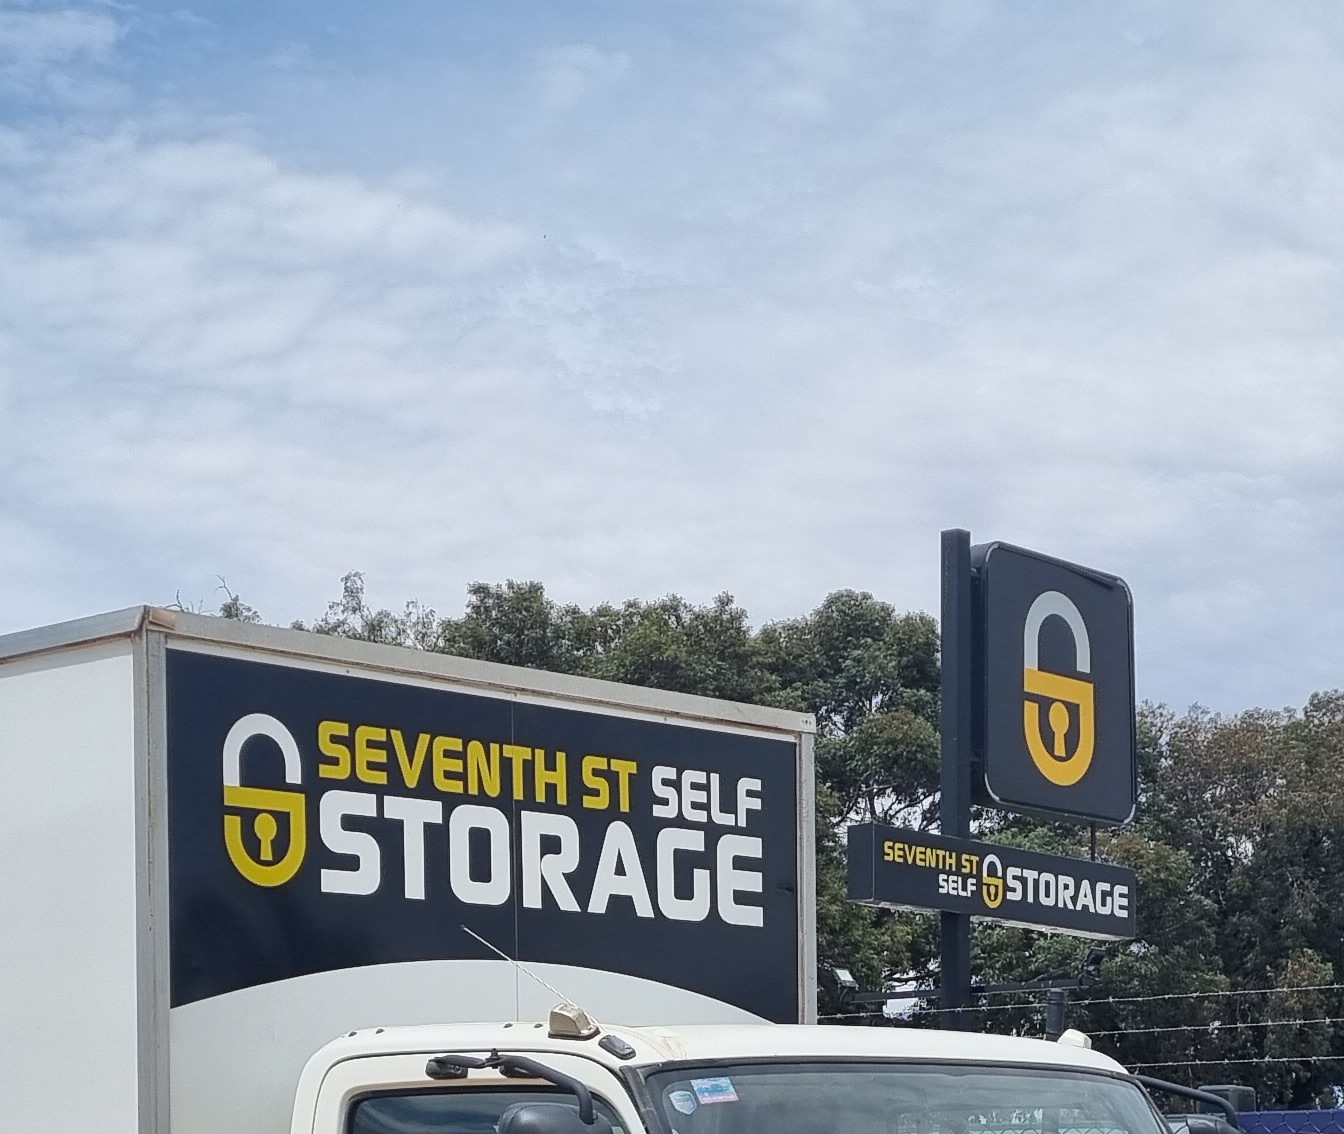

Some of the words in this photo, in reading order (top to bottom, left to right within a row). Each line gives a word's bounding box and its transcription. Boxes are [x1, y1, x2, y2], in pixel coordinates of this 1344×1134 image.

[319, 720, 568, 805] SEVENTH
[581, 755, 638, 812] ST
[651, 765, 763, 828] SELF
[319, 789, 764, 928] STORAGE
[883, 840, 956, 871] SEVENTH
[961, 855, 979, 875] ST
[938, 873, 977, 898] SELF
[1006, 866, 1129, 919] STORAGE
